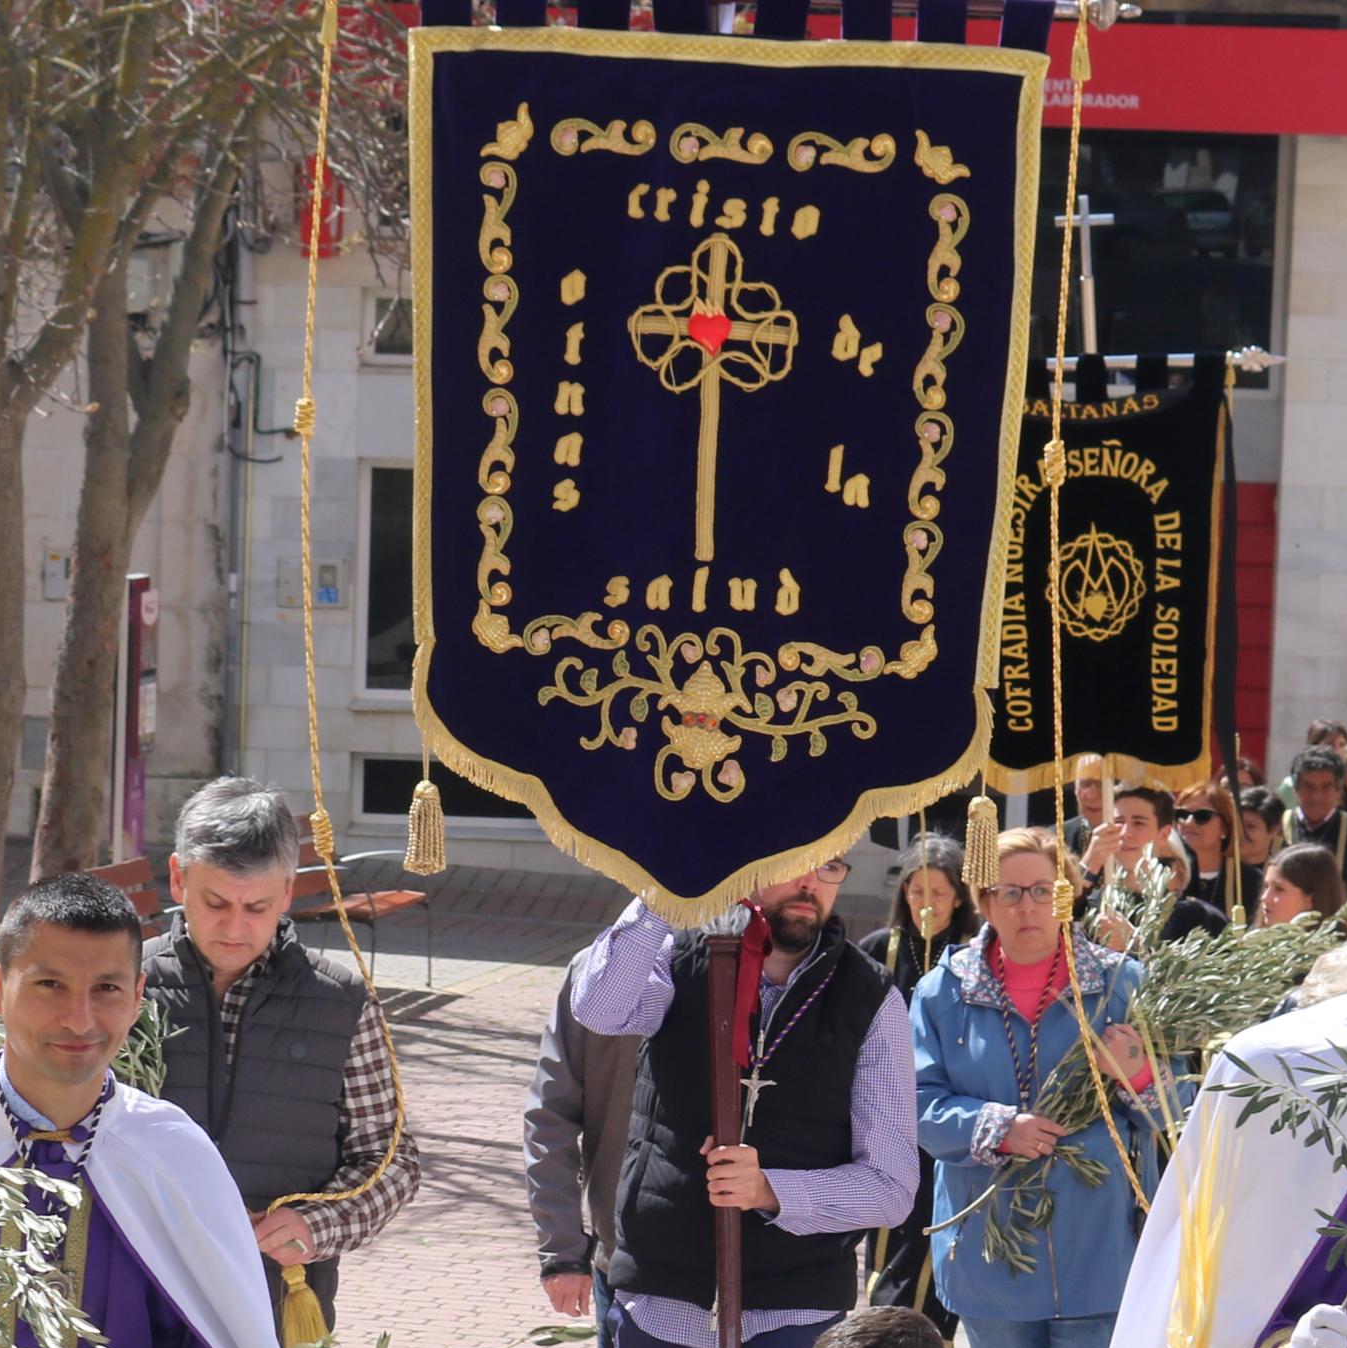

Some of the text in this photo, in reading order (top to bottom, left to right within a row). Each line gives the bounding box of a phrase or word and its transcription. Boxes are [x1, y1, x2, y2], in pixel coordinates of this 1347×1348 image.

[1043, 92, 1140, 109] LABRADOR
[824, 313, 884, 509] de la
[1067, 438, 1170, 506] SEÑORA
[1153, 510, 1182, 552] DE
[603, 565, 801, 616] salud
[1154, 560, 1181, 593] LA
[1150, 605, 1181, 734] SOLEDAD
